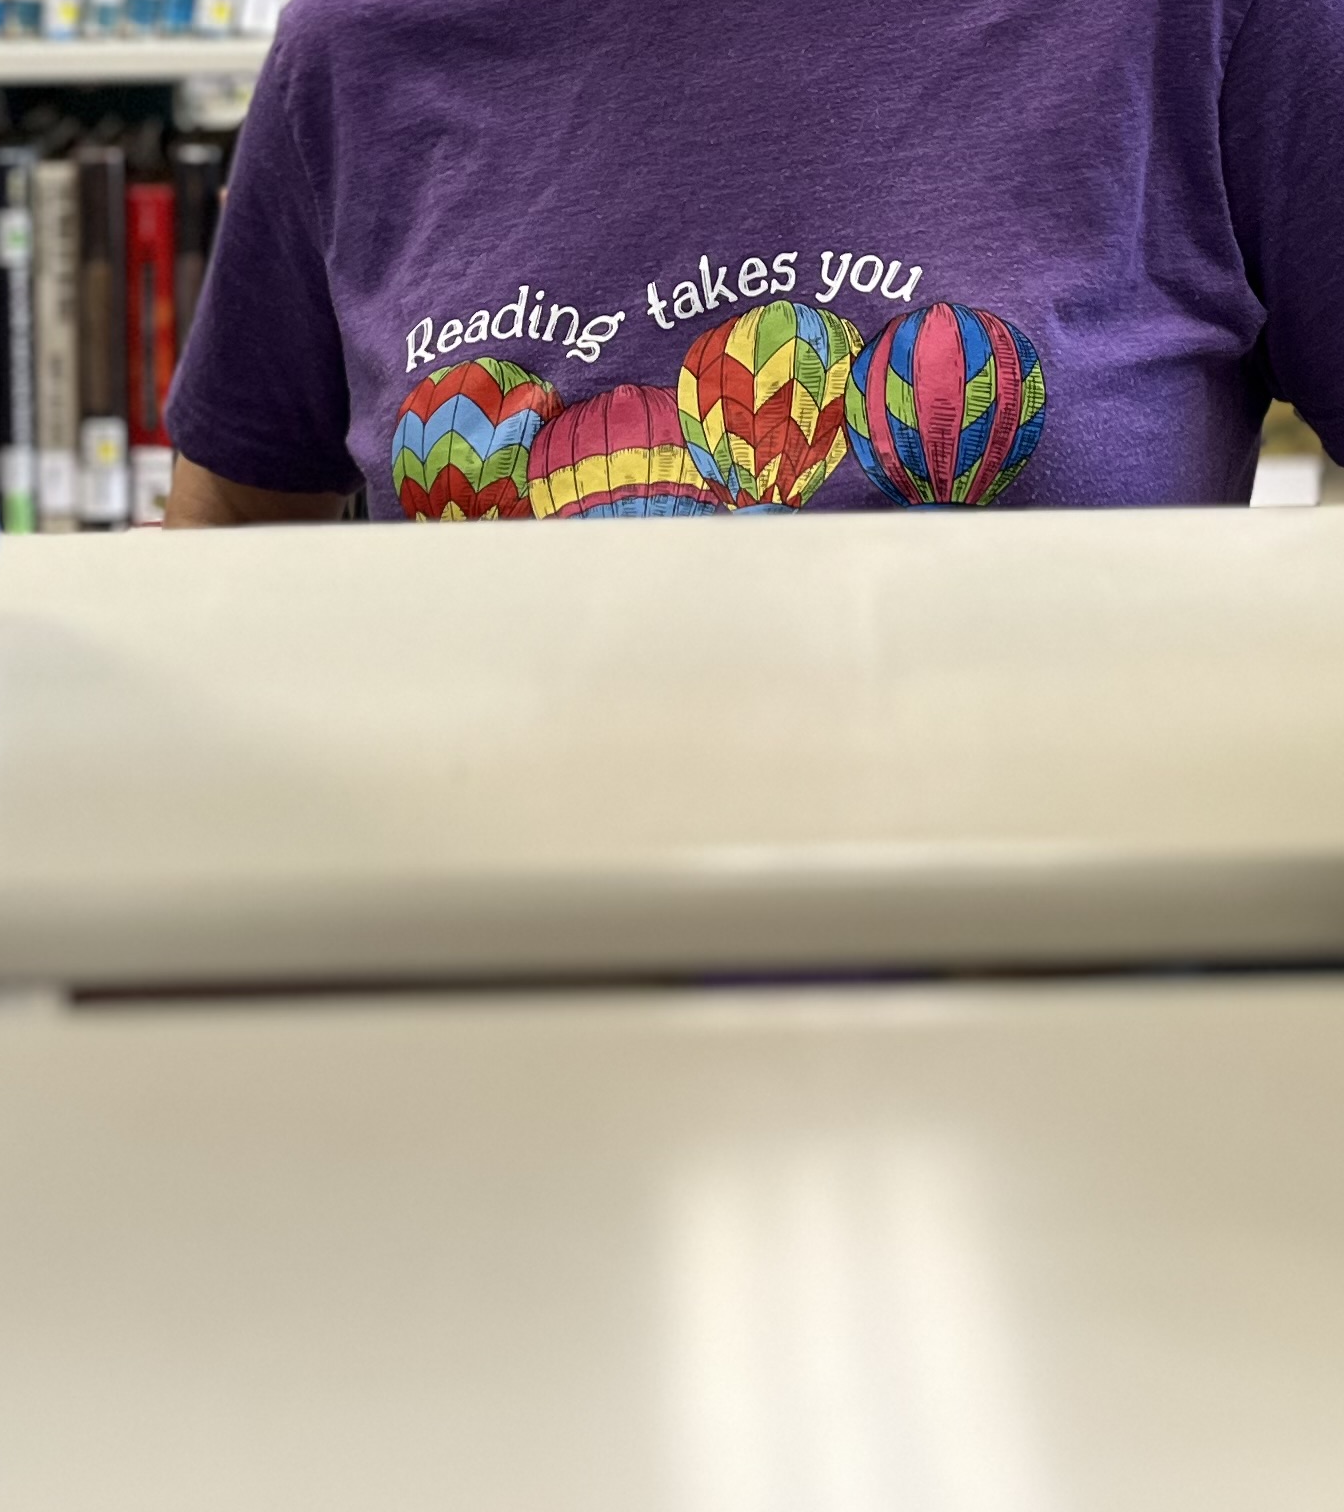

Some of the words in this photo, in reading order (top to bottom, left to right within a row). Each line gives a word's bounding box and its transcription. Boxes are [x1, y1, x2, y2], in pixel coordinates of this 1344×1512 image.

[404, 285, 626, 373] Reading
[646, 251, 799, 330] takes
[815, 250, 924, 304] you
